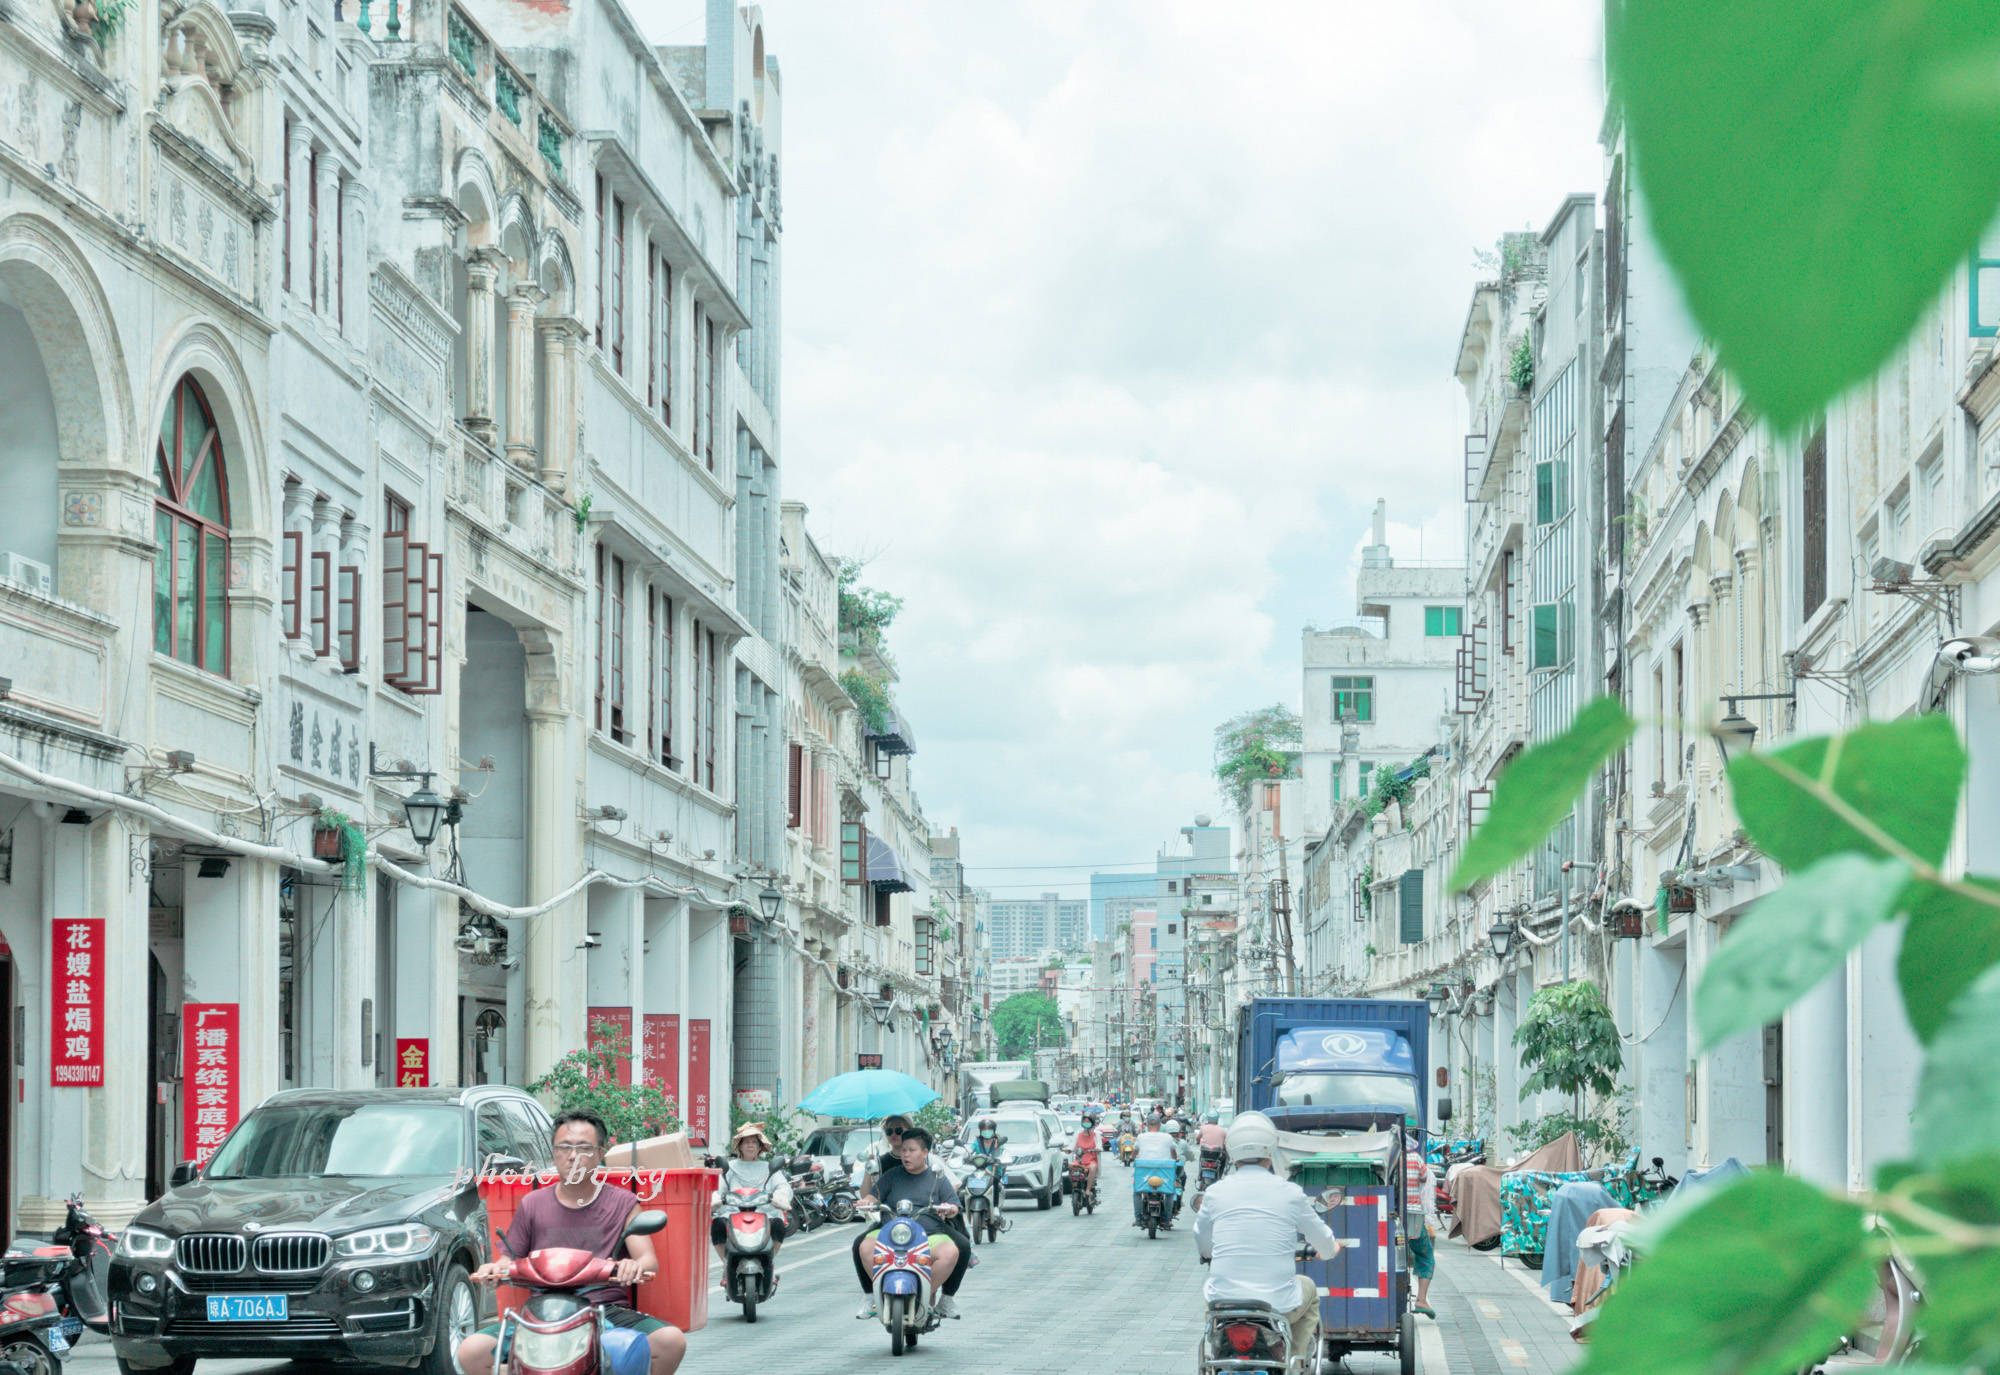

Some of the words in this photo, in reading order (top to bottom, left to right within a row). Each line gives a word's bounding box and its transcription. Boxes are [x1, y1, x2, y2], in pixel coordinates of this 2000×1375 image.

[65, 923, 92, 1061] 花嫂盐焗鸡
[55, 1064, 101, 1083] 19943301147
[695, 1093, 707, 1139] 欢迎光临
